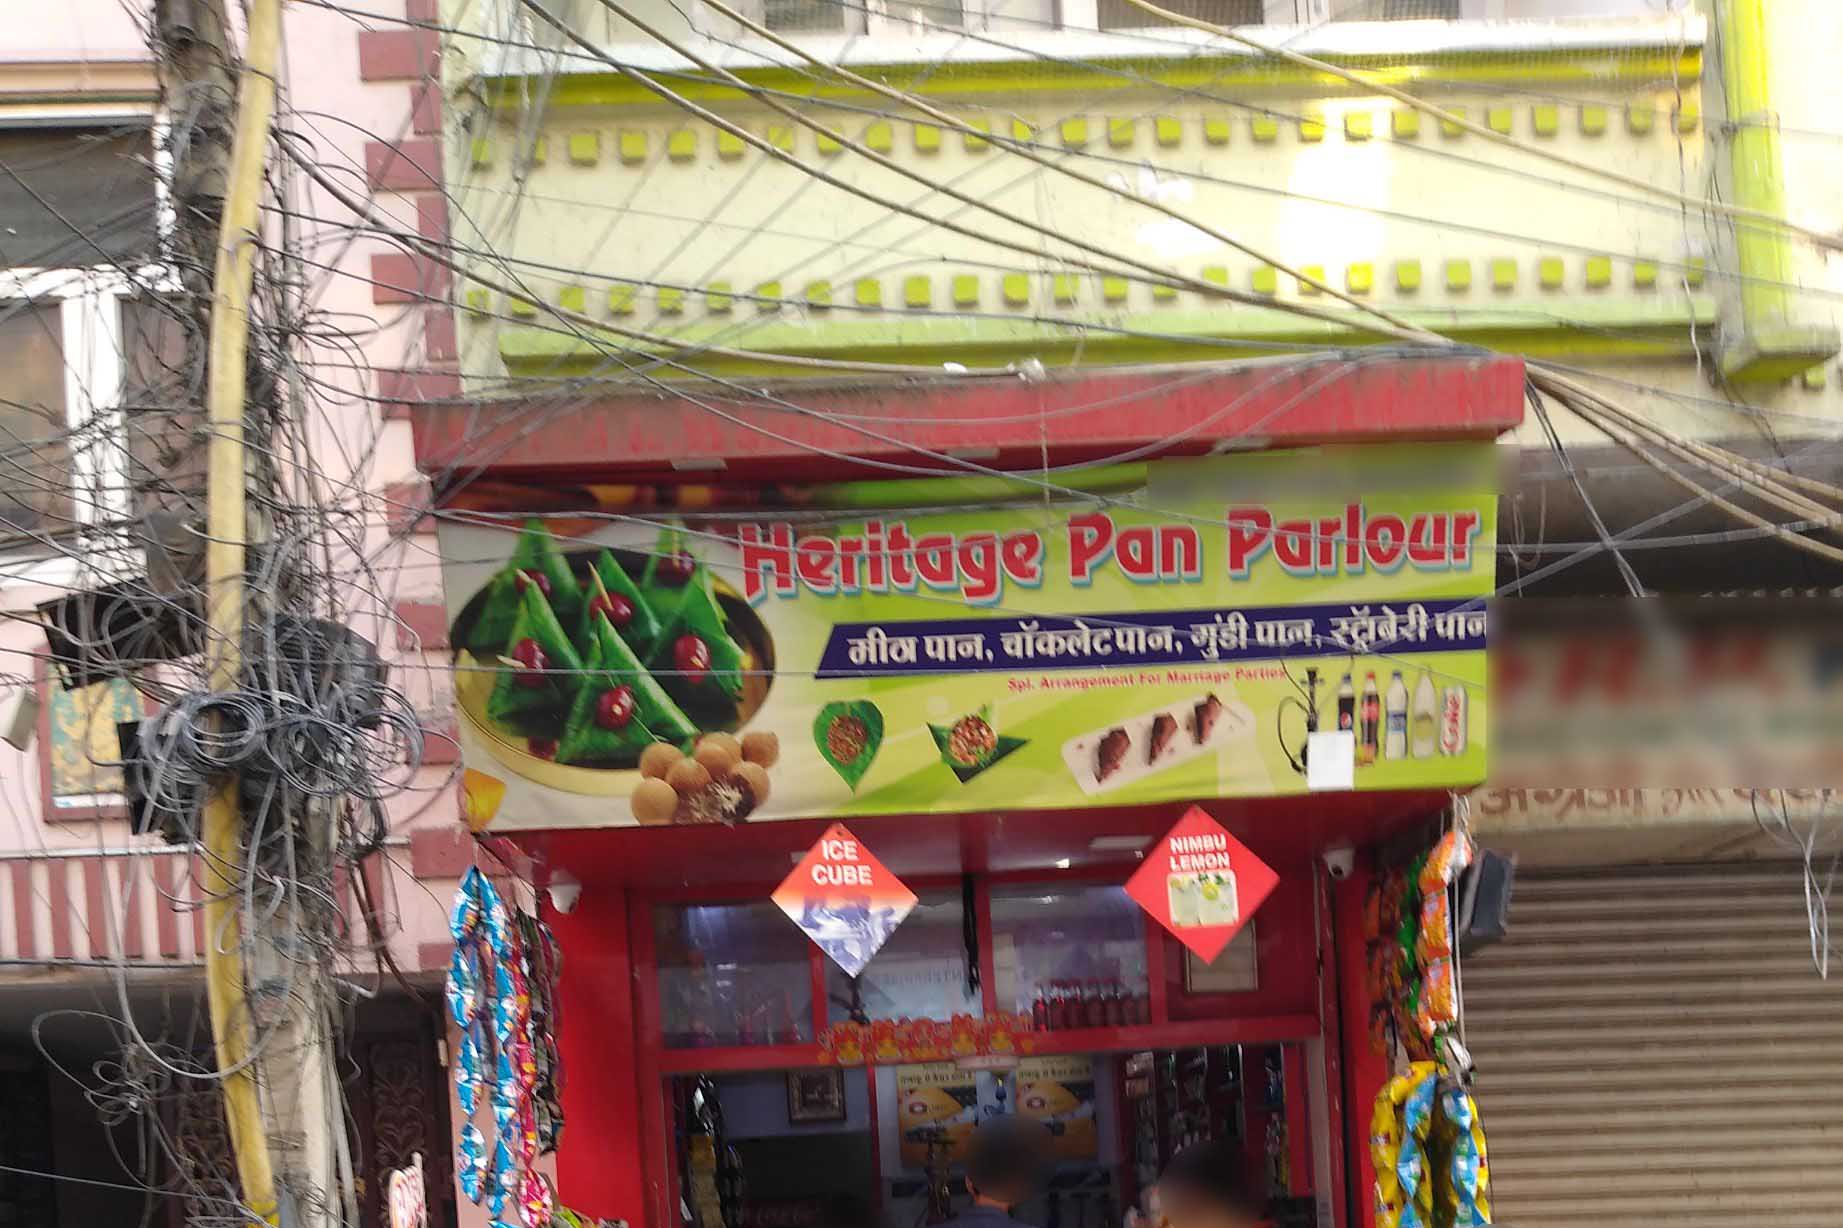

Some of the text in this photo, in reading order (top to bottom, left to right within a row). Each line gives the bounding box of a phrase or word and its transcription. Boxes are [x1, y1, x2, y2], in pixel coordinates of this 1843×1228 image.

[739, 503, 1480, 607] Heritage Pan Parlour
[1040, 673, 1135, 690] Arrangement
[1139, 670, 1160, 685] For
[1166, 669, 1231, 686] Marriage
[1235, 667, 1286, 681] Parties
[821, 839, 858, 862] ICE
[1169, 833, 1228, 855] NIMBU
[1169, 851, 1231, 872] LEMON
[811, 863, 874, 886] CUBE
